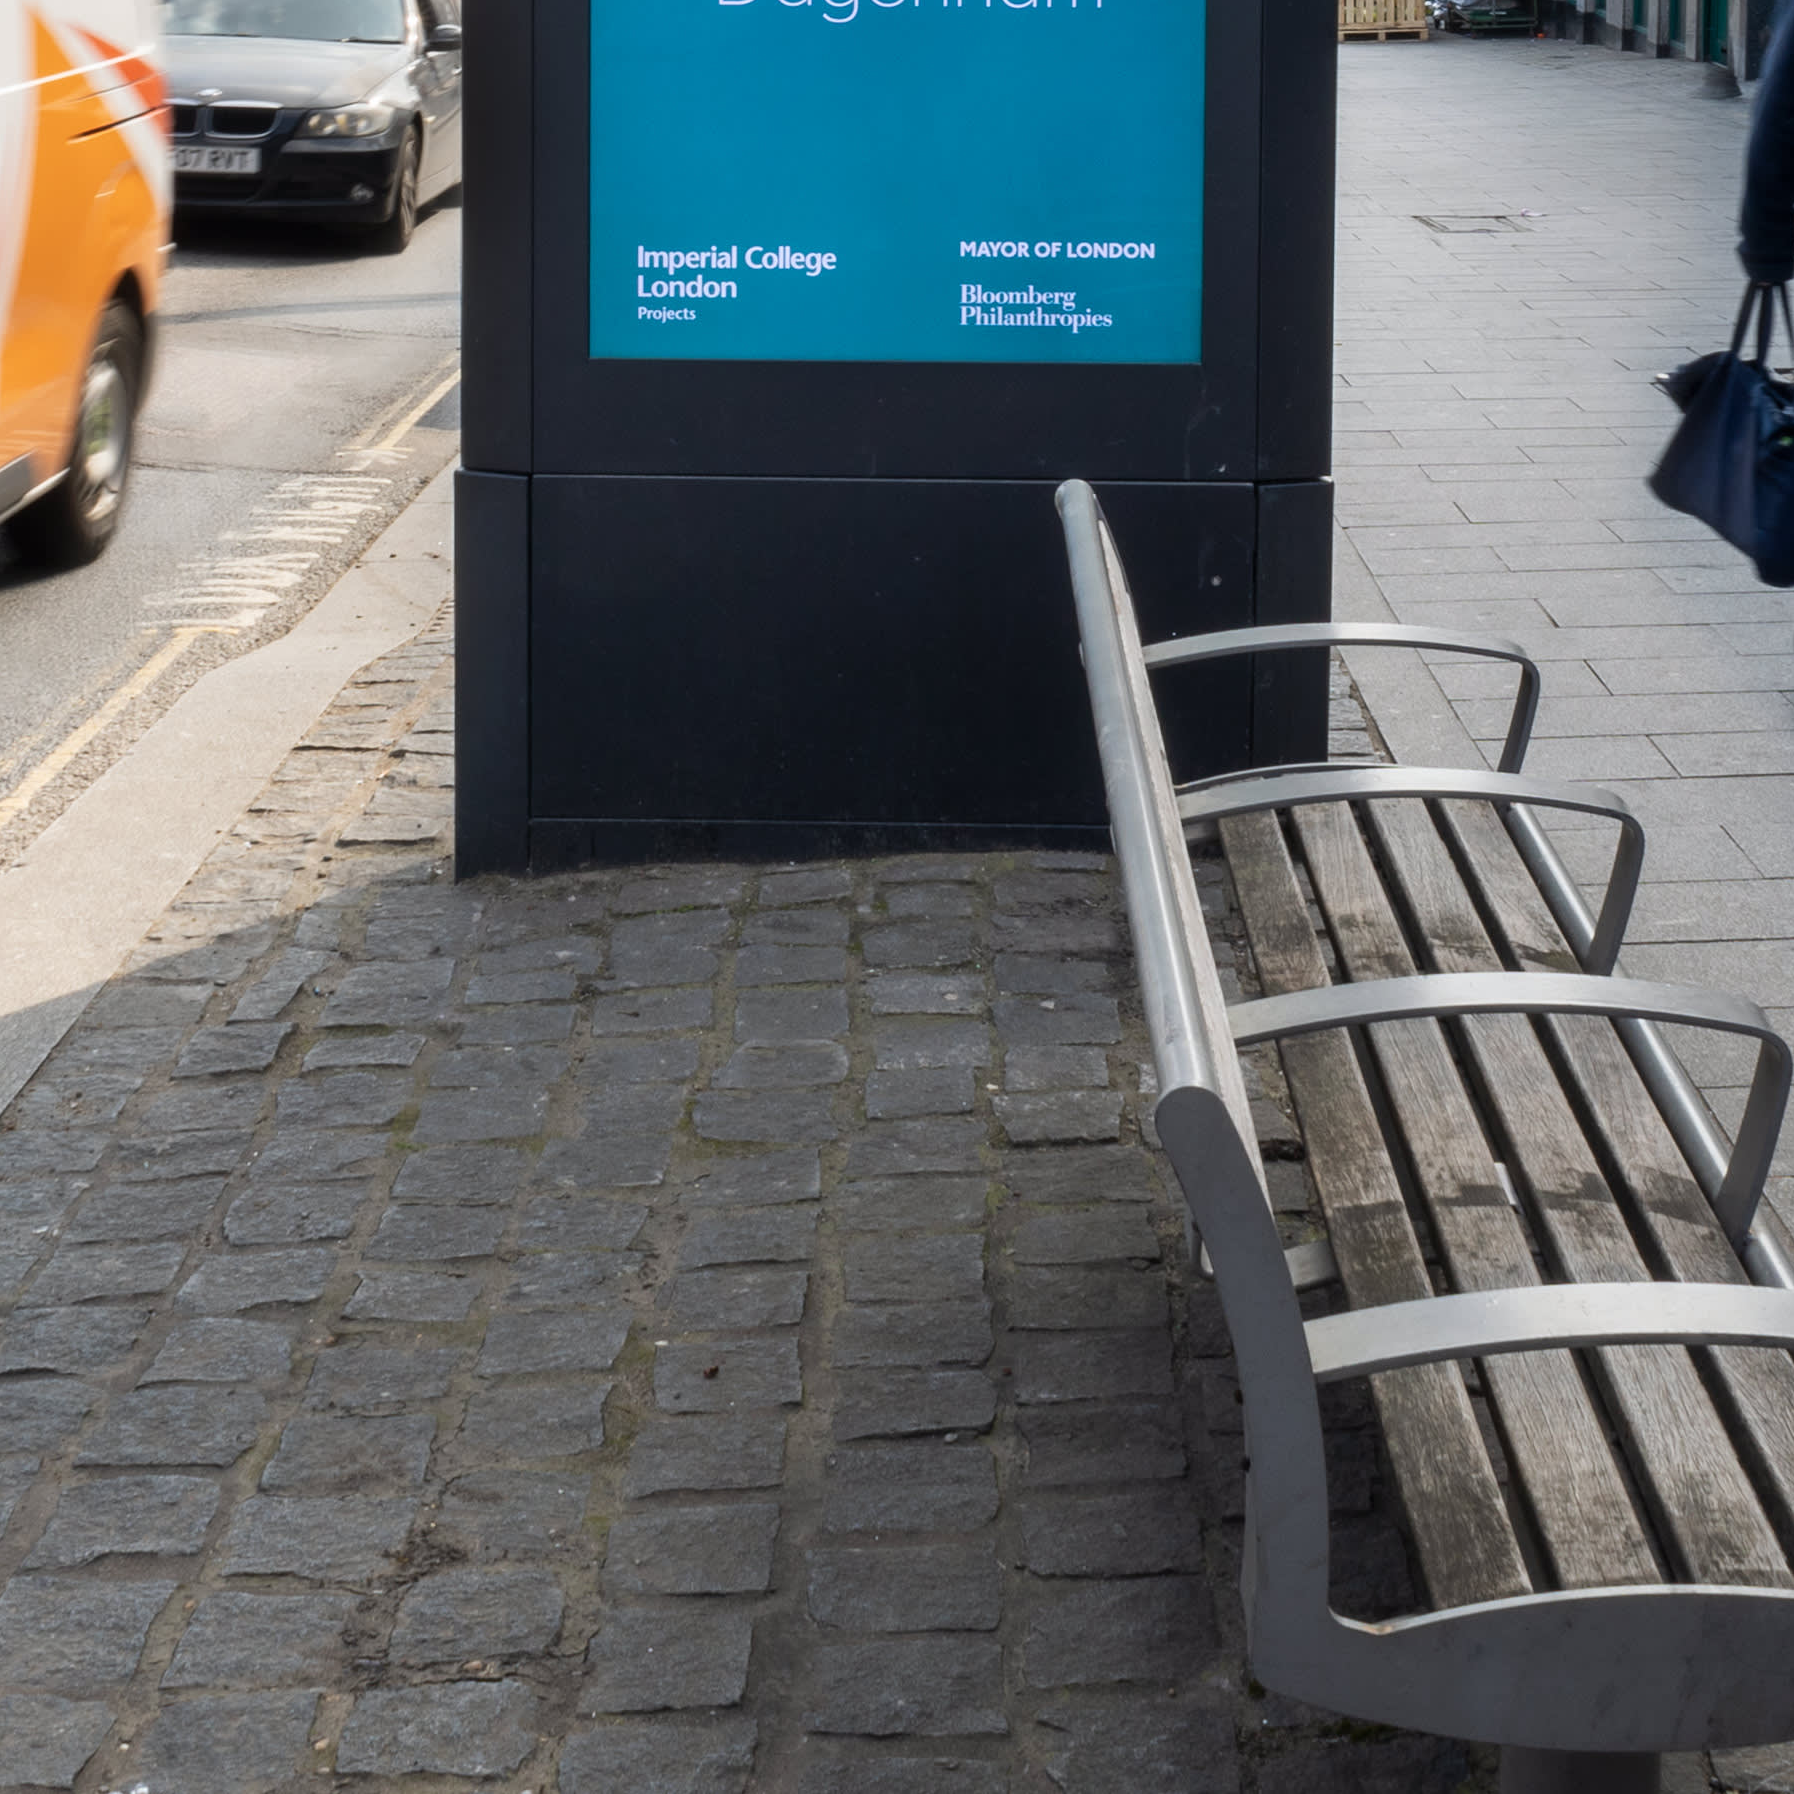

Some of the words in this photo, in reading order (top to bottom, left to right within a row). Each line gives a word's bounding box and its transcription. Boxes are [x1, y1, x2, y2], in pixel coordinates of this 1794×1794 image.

[637, 245, 738, 275] Imperial
[744, 245, 837, 276] College
[960, 241, 1030, 258] MAYOR
[1034, 241, 1062, 258] OF
[1066, 242, 1156, 259] LONDON
[637, 275, 737, 299] London
[960, 284, 1077, 310] Bloomberg
[637, 306, 697, 323] Projects
[960, 306, 1113, 334] Philanthropies
